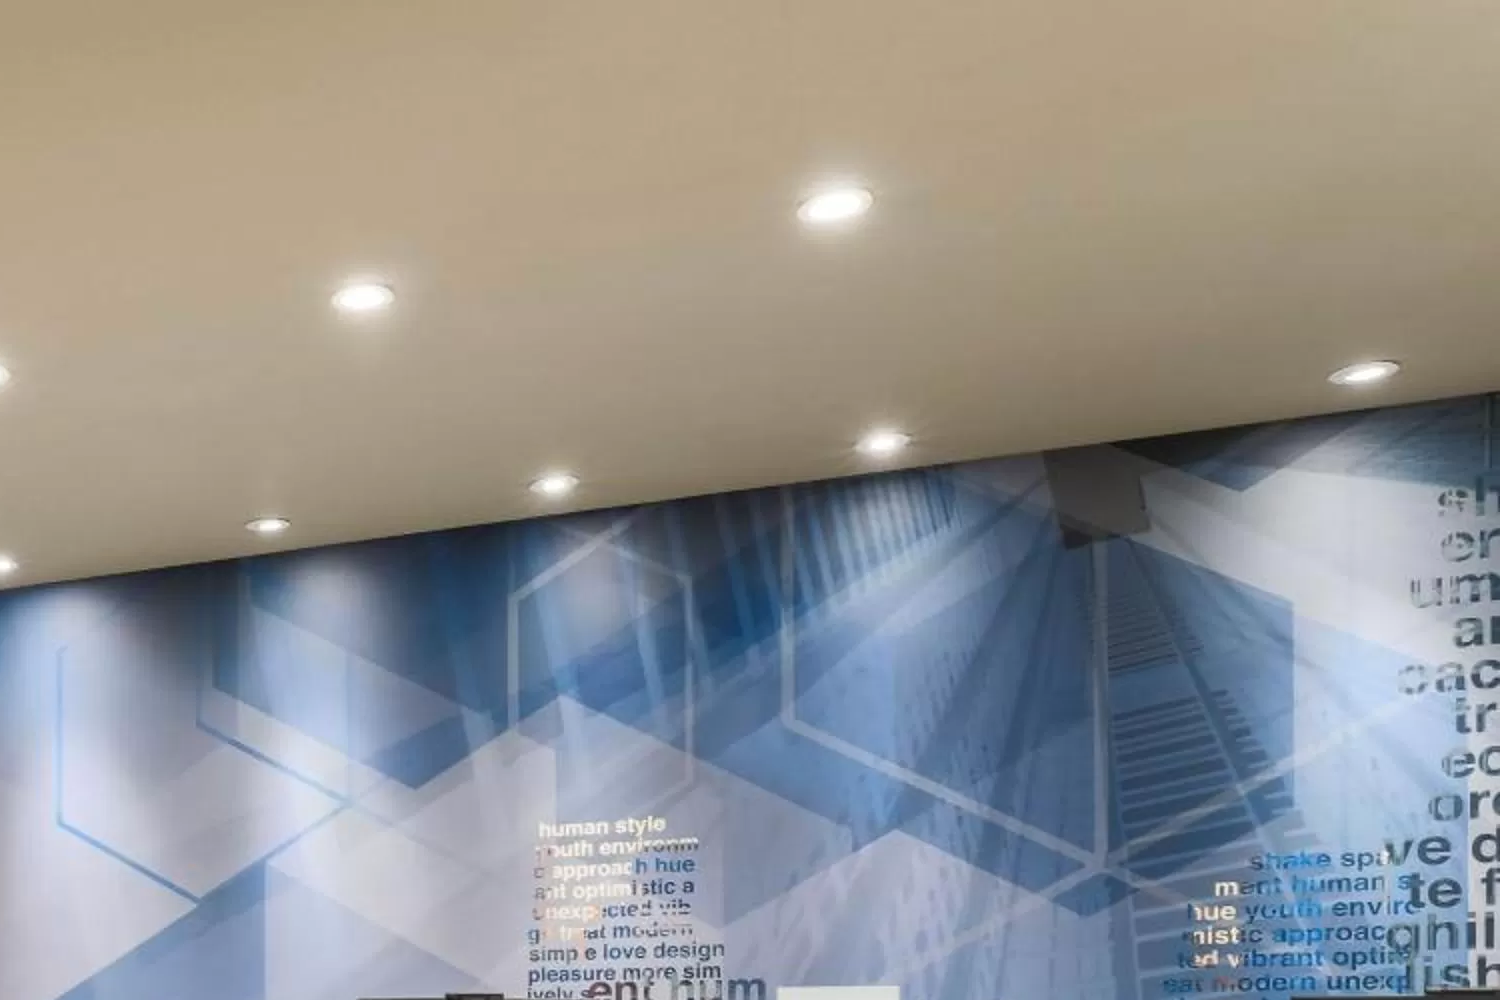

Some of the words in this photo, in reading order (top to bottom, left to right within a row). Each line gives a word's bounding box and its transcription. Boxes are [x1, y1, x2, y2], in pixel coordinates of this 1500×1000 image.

[538, 820, 609, 838] human
[615, 815, 667, 837] style
[655, 857, 696, 874] hue
[1251, 851, 1332, 871] shake
[1292, 873, 1385, 893] human
[1187, 902, 1237, 922] hue
[603, 943, 647, 960] love
[653, 940, 725, 962] design
[528, 966, 617, 986] pleasure
[623, 966, 677, 981] more
[682, 962, 722, 979] sim
